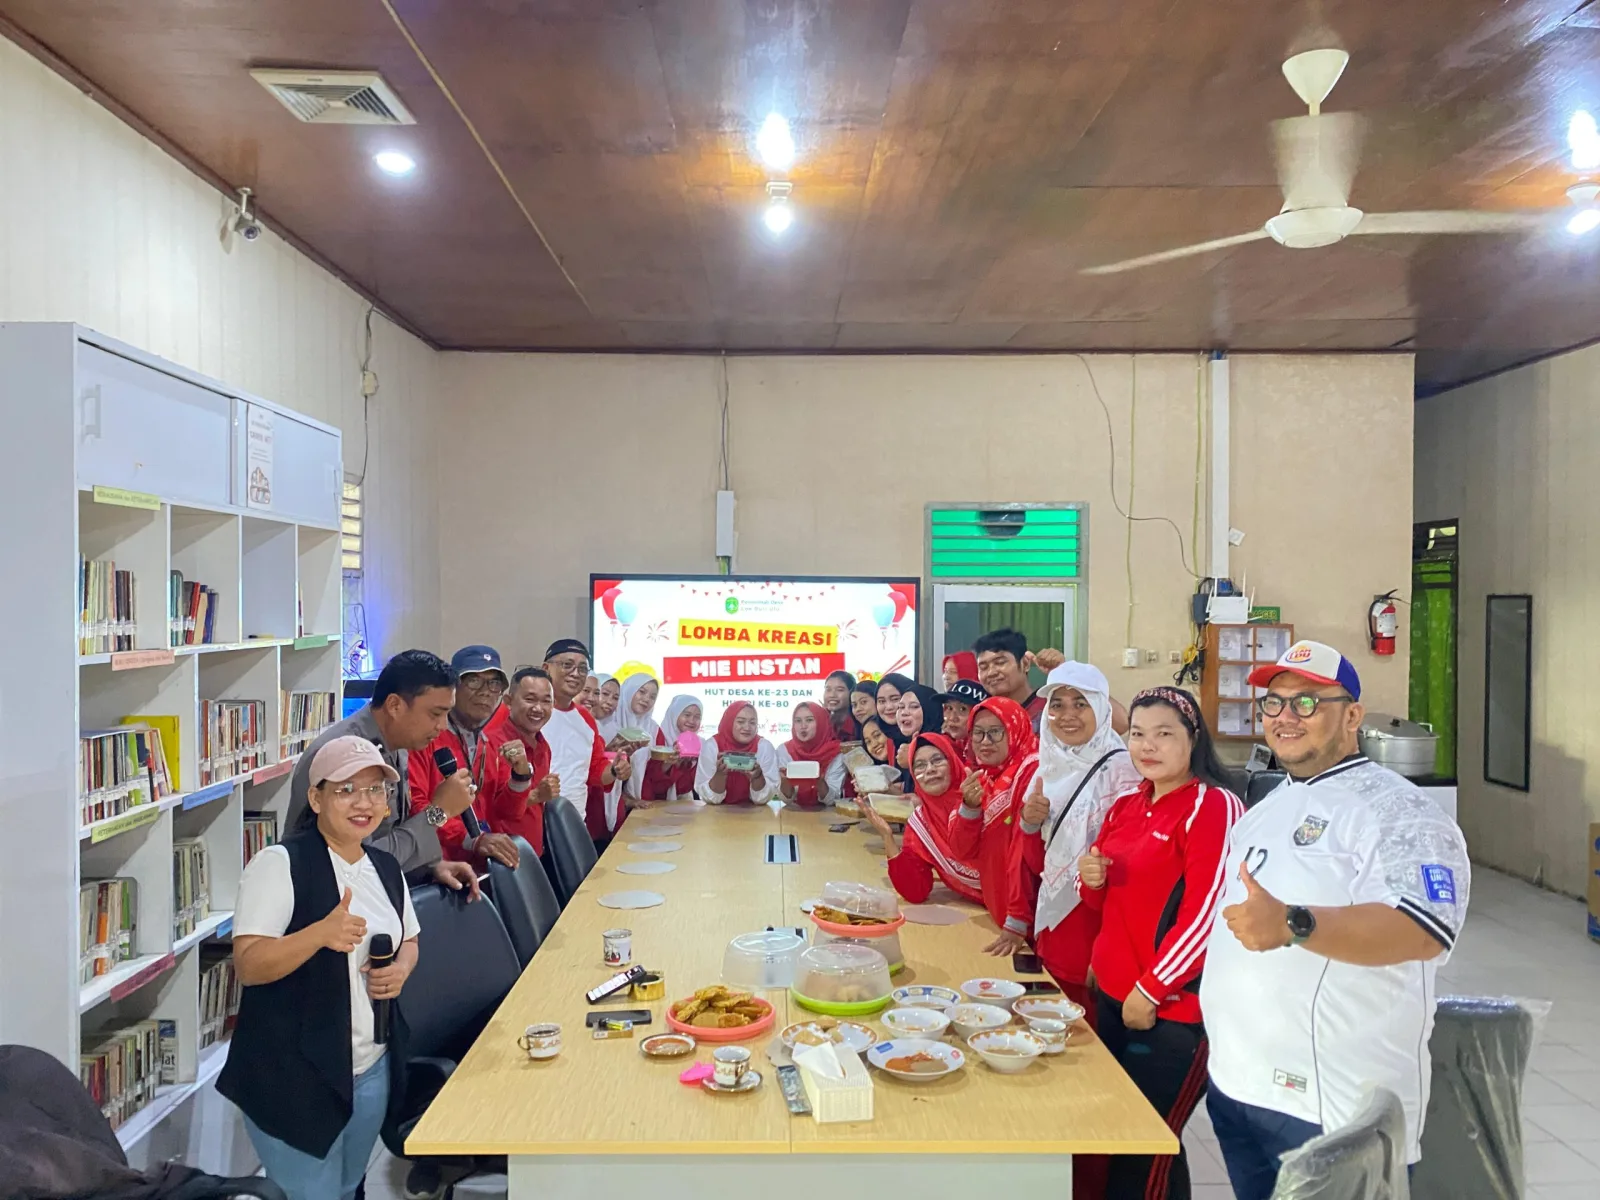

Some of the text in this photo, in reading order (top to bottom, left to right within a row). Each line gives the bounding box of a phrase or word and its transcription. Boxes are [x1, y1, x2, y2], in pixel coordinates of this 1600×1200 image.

[681, 625, 832, 646] LOMBA KREASI
[691, 657, 820, 677] MIE INSTAN
[704, 688, 813, 697] HUT DESA KE-23 DAN
[758, 700, 789, 708] KE-80
